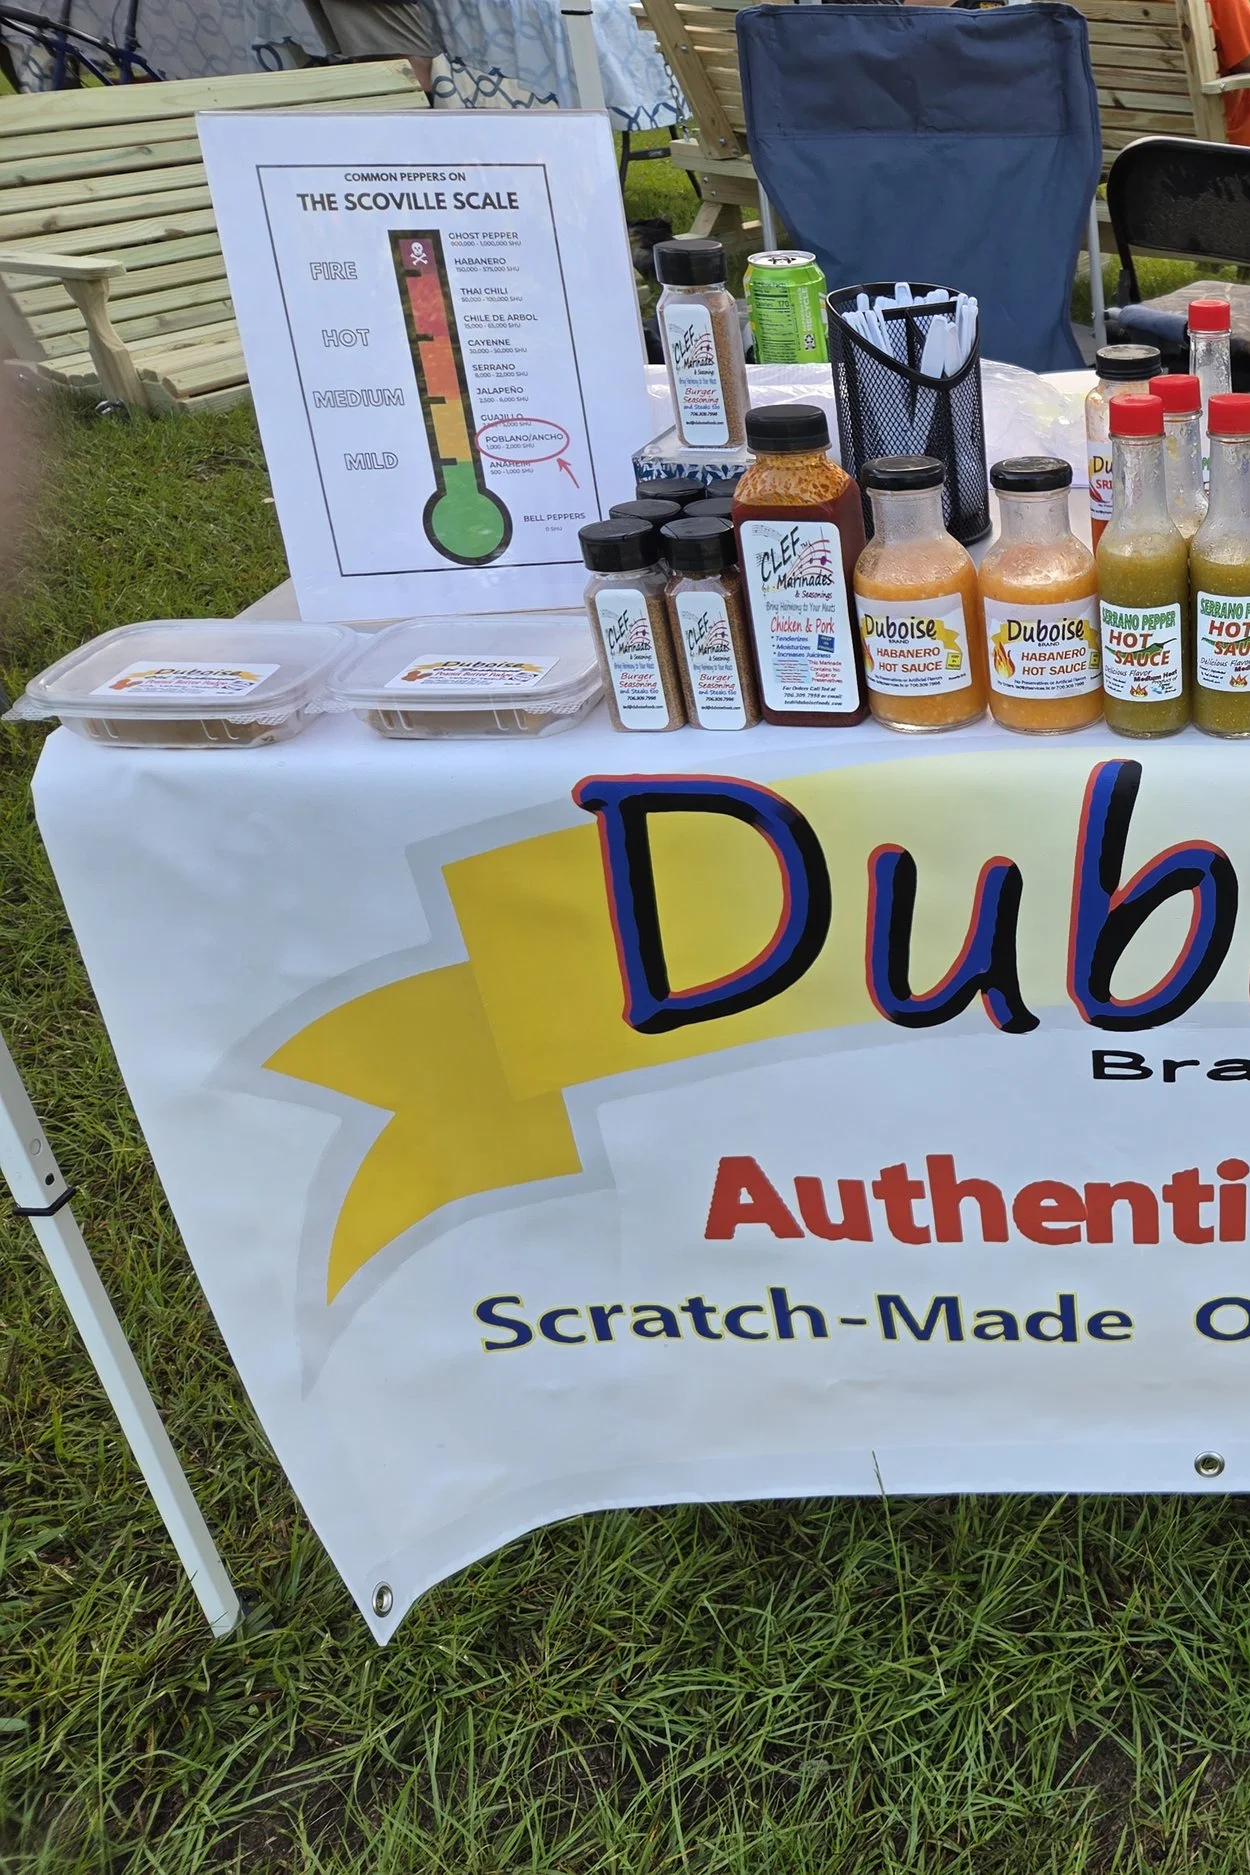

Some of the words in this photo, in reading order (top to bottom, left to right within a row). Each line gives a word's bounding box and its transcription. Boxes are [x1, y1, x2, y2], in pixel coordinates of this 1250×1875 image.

[344, 172, 398, 182] COMMON
[400, 172, 446, 182] PEPPERS
[449, 172, 466, 181] ON
[296, 193, 339, 211] THE
[344, 192, 448, 211] SCOVILLE
[453, 191, 520, 210] SCALE
[448, 232, 480, 240] GHOST
[482, 231, 519, 240] PEPPER
[454, 257, 507, 266] HABANERO
[309, 261, 358, 280] FIRE
[460, 287, 482, 296] THAI
[484, 287, 509, 295] CHILI
[463, 314, 490, 322] CHILE
[492, 314, 505, 322] DE
[507, 313, 539, 321] ARBOL
[322, 328, 370, 347] HOT
[467, 338, 511, 347] CAYENNE
[674, 324, 695, 364] CLEF
[472, 363, 516, 372] SERRANO
[476, 385, 524, 395] JALAPEÑO
[684, 387, 717, 397] Burger
[313, 388, 405, 409] MEDIUM
[683, 396, 720, 405] Seasoning
[480, 413, 524, 422] GUAJILLO
[485, 433, 564, 443] POBLANO/ANCHO
[344, 452, 399, 471] MILD
[523, 513, 545, 523] BELL
[546, 512, 586, 521] PEPPERS
[761, 525, 800, 582] CLEF
[776, 569, 835, 590] Marinades
[802, 590, 833, 601] Seasonings
[1200, 597, 1244, 620] SERRANO
[1102, 605, 1140, 628] SERRANO
[1141, 610, 1177, 631] PEPPER
[608, 609, 629, 650] CLEF
[688, 611, 709, 651] CLEF
[770, 616, 802, 633] Chicken
[805, 618, 813, 633] &
[815, 617, 835, 634] Pork
[863, 613, 937, 640] Duboise
[1007, 617, 1085, 643] Duboise
[1109, 629, 1153, 649] HOT
[806, 651, 831, 659] Juiciness
[876, 646, 941, 659] HABANERO
[1021, 647, 1087, 662] HABANERO
[1114, 649, 1171, 668] SAUCE
[441, 660, 526, 668] Duboise
[878, 661, 898, 673] HOT
[901, 660, 943, 673] SAUCE
[1200, 656, 1229, 667] Delicious
[154, 667, 243, 676] Duboise
[1022, 665, 1047, 676] HOT
[1049, 661, 1087, 676] SAUCE
[1104, 664, 1128, 677] Delicious
[620, 672, 655, 681] Burger
[700, 673, 733, 682] Burger
[619, 680, 658, 690] Seasoning
[697, 681, 736, 691] Seasoning
[473, 1285, 1136, 1353] Scratch-Made
